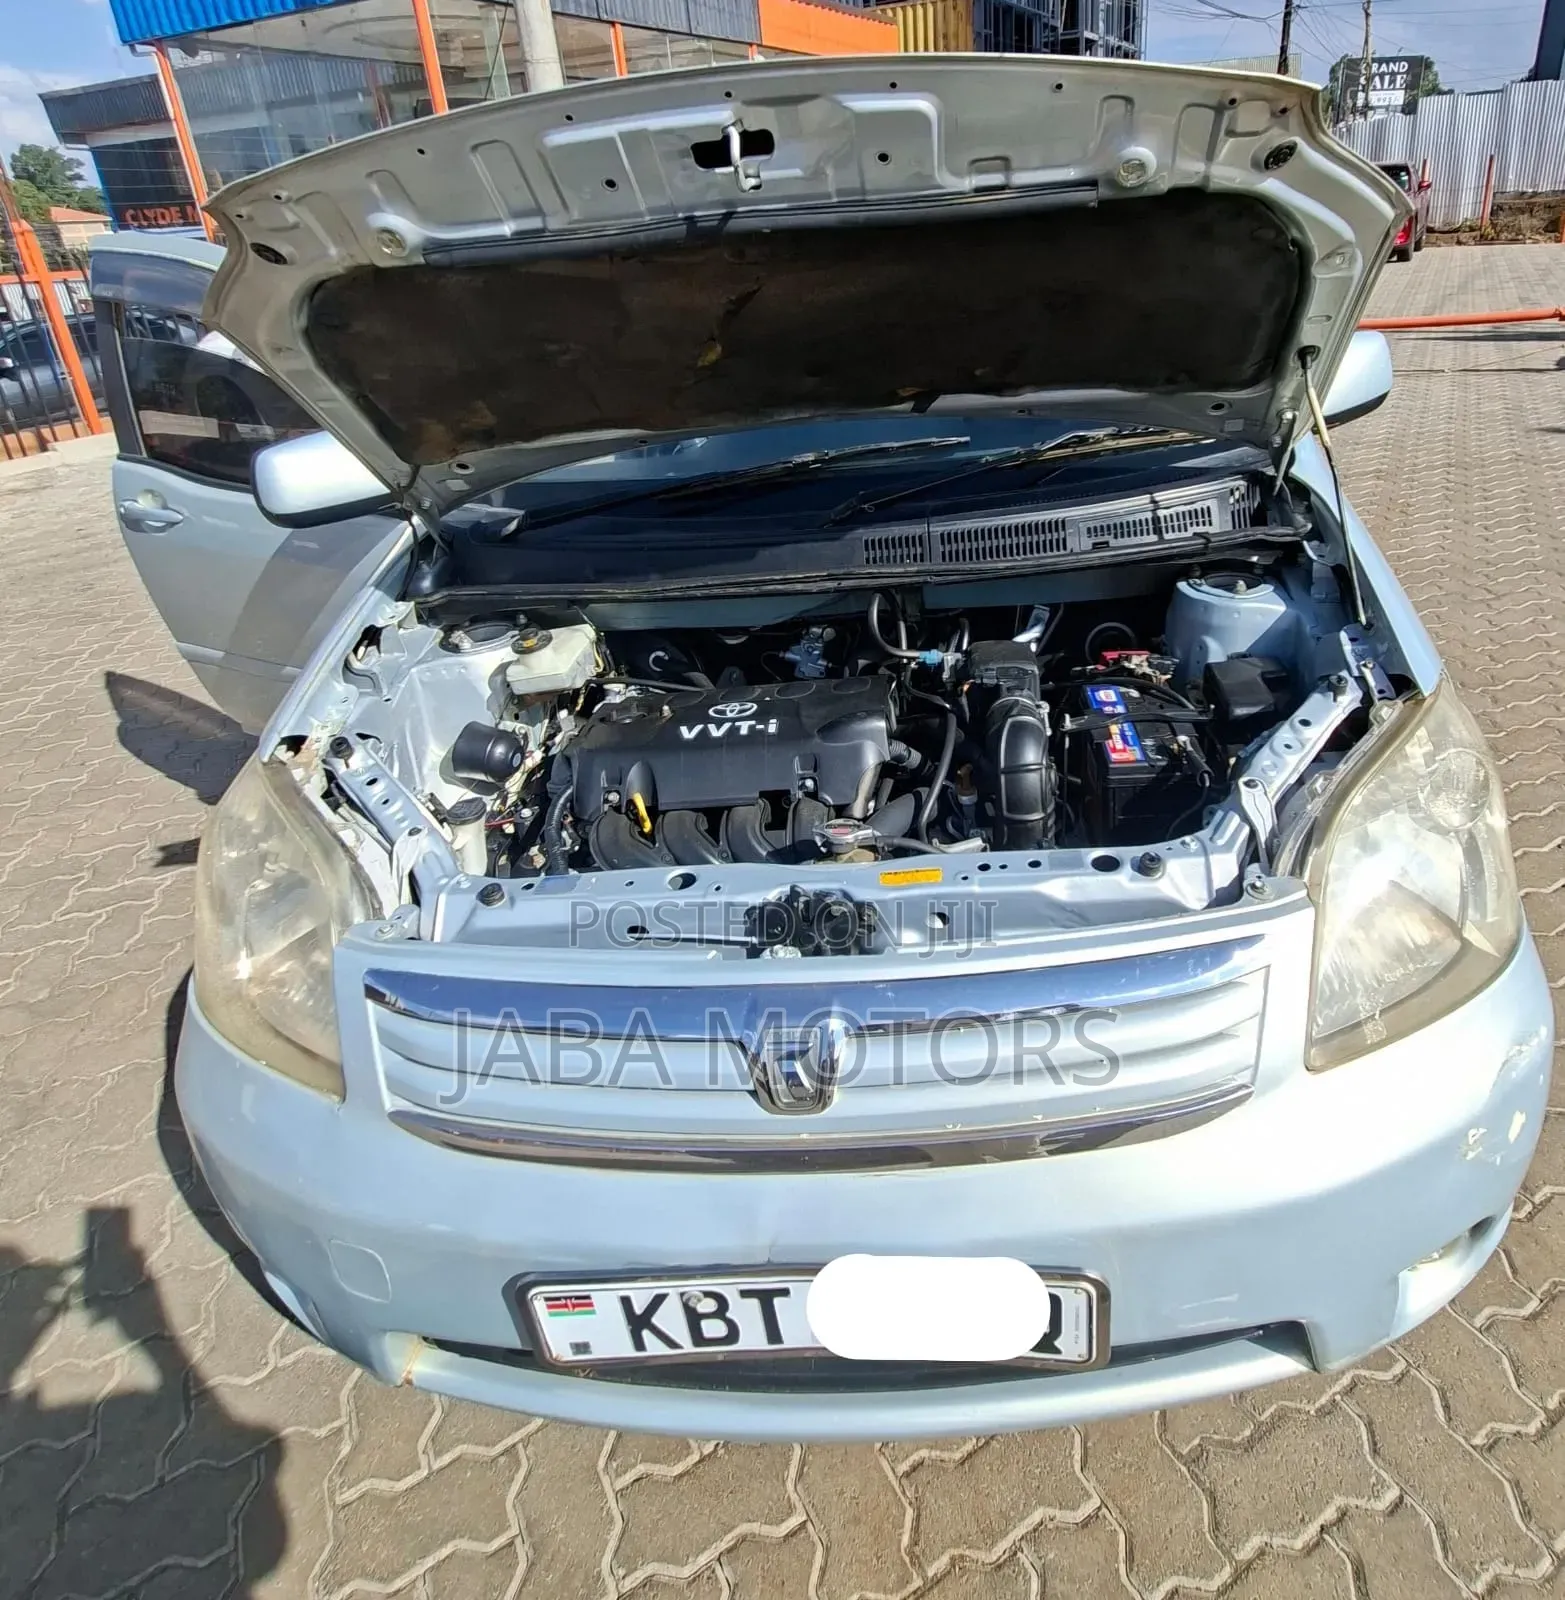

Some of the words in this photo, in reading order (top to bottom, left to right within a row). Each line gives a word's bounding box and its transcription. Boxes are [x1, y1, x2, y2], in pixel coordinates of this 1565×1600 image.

[125, 206, 182, 226] CLYDE
[680, 719, 777, 739] VVT-i
[619, 1287, 792, 1352] KBT
